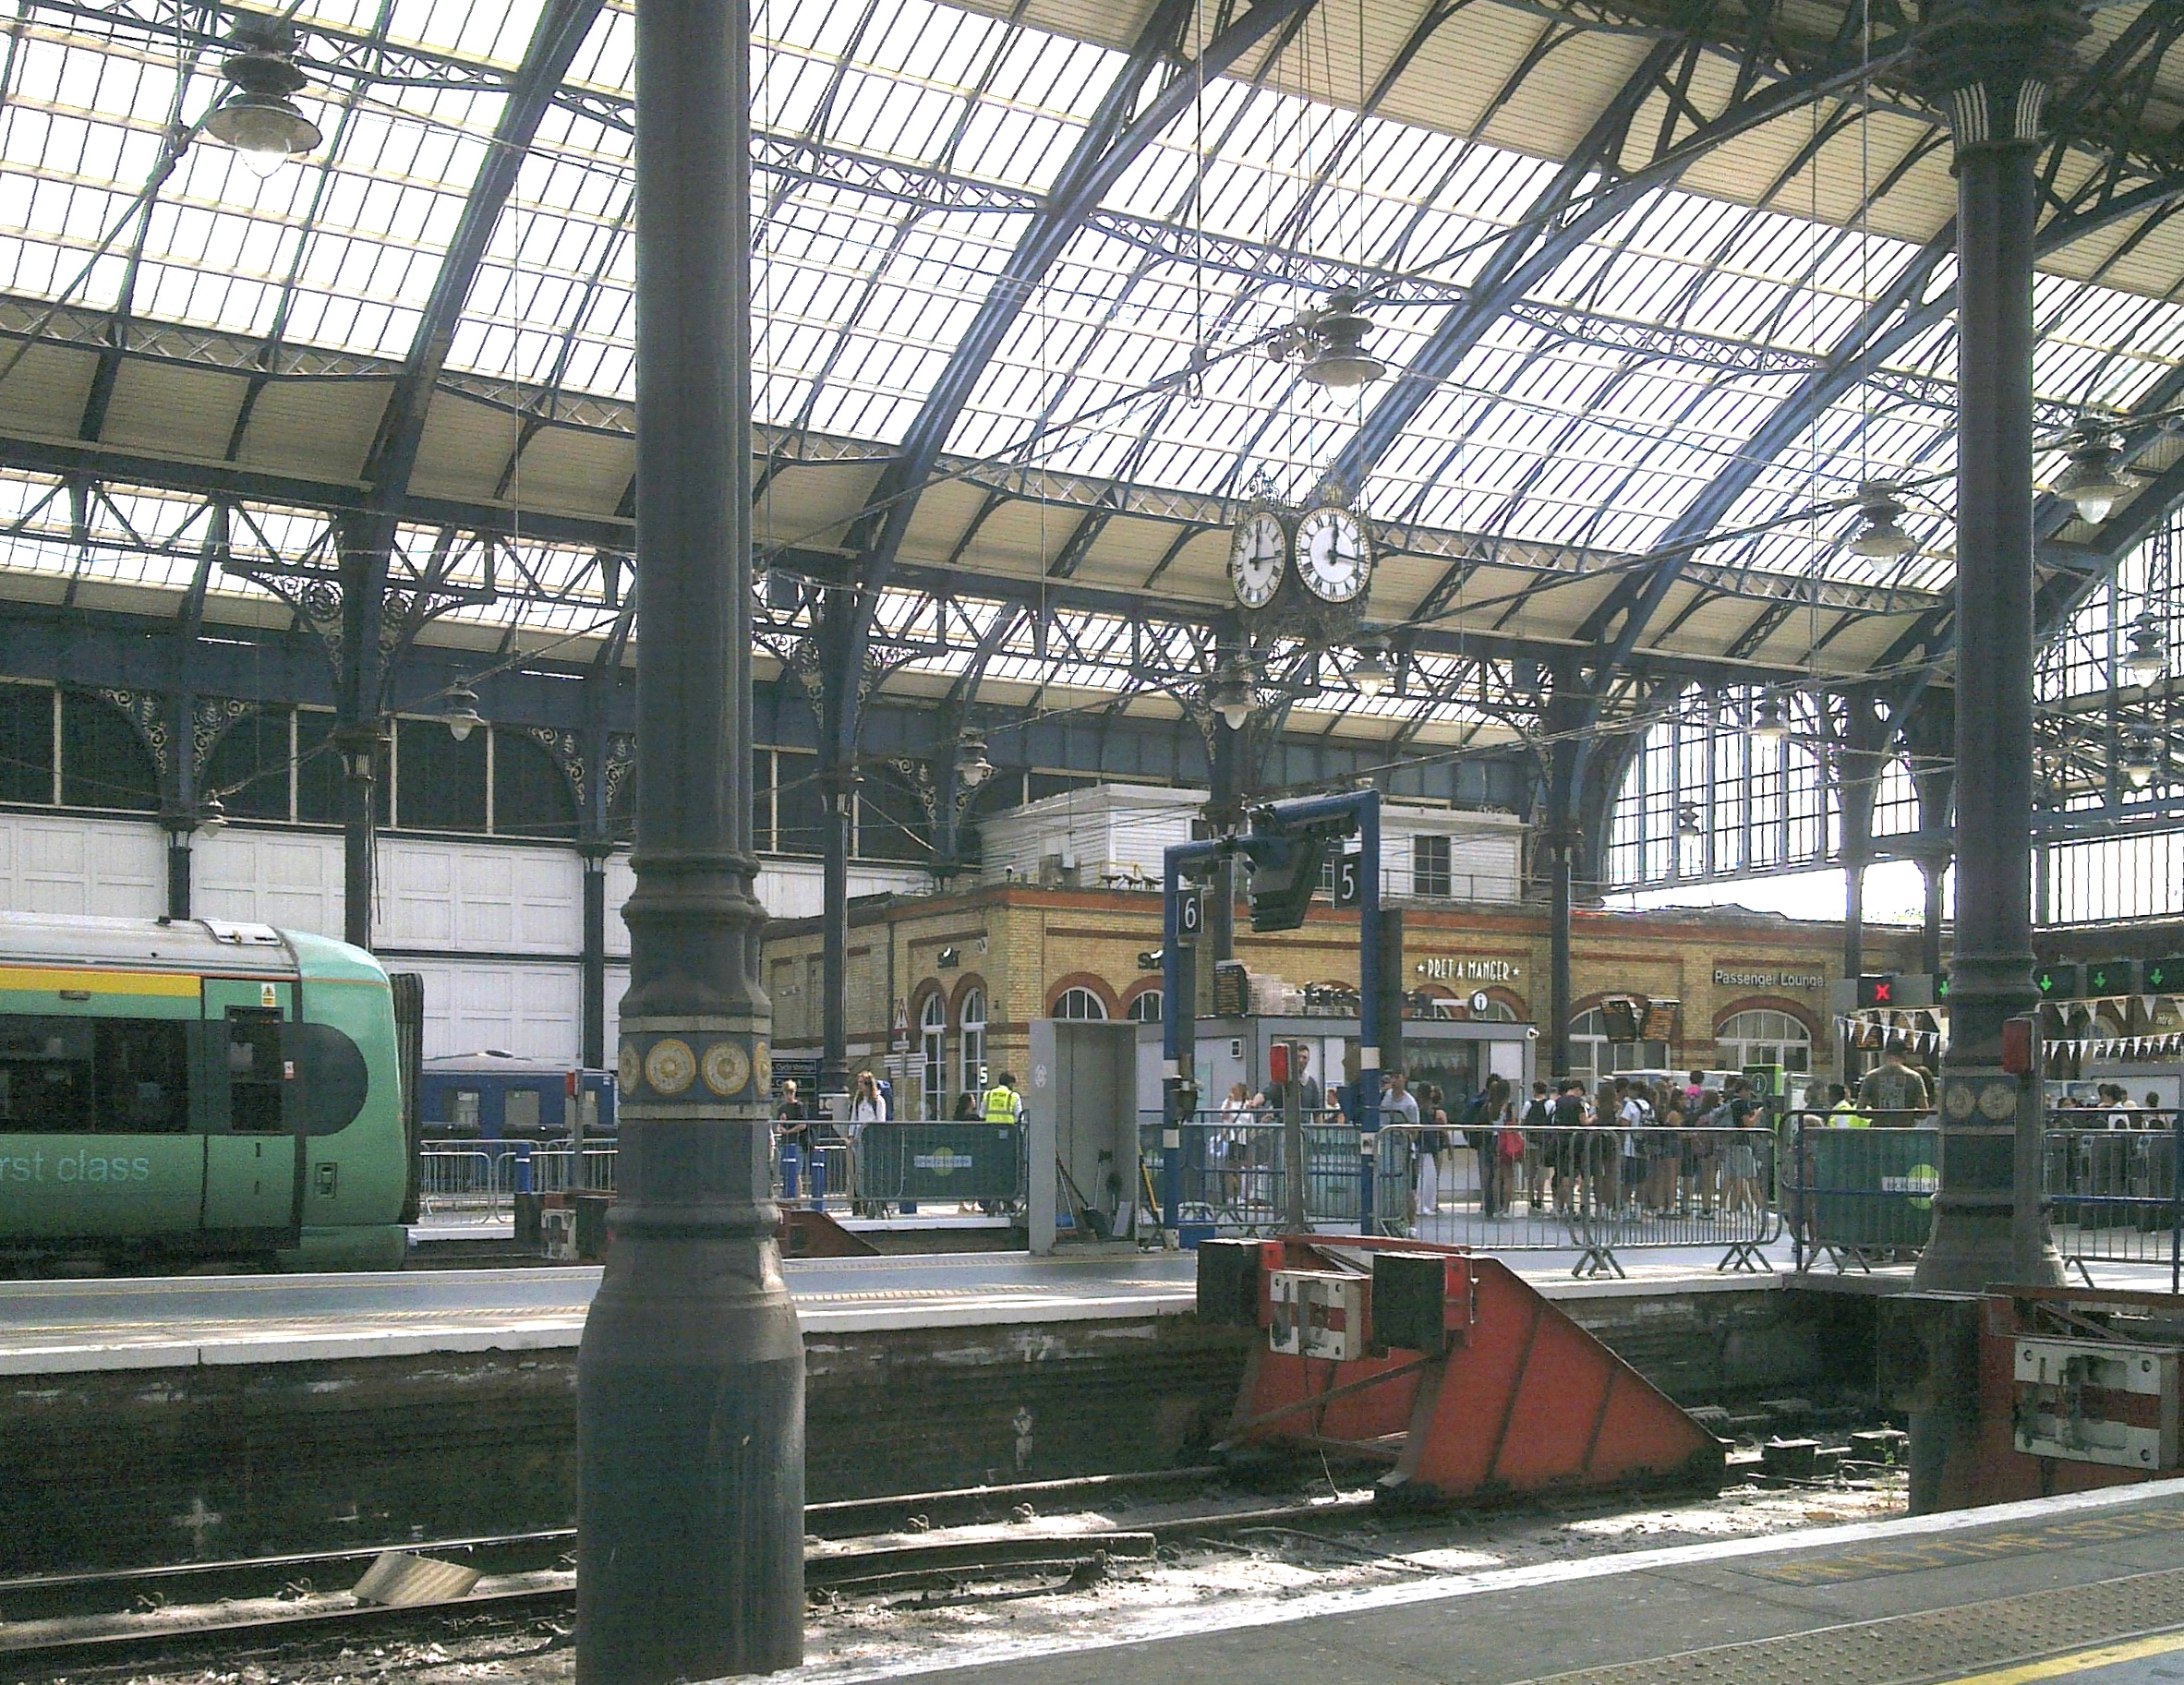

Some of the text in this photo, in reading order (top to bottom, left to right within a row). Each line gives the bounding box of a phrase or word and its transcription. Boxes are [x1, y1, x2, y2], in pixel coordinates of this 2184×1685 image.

[1341, 863, 1355, 900] 5
[1184, 897, 1197, 929] 6
[1428, 958, 1509, 981] PRET A MANGER
[1714, 970, 1825, 989] Passenger Lounge
[57, 1149, 150, 1182] class
